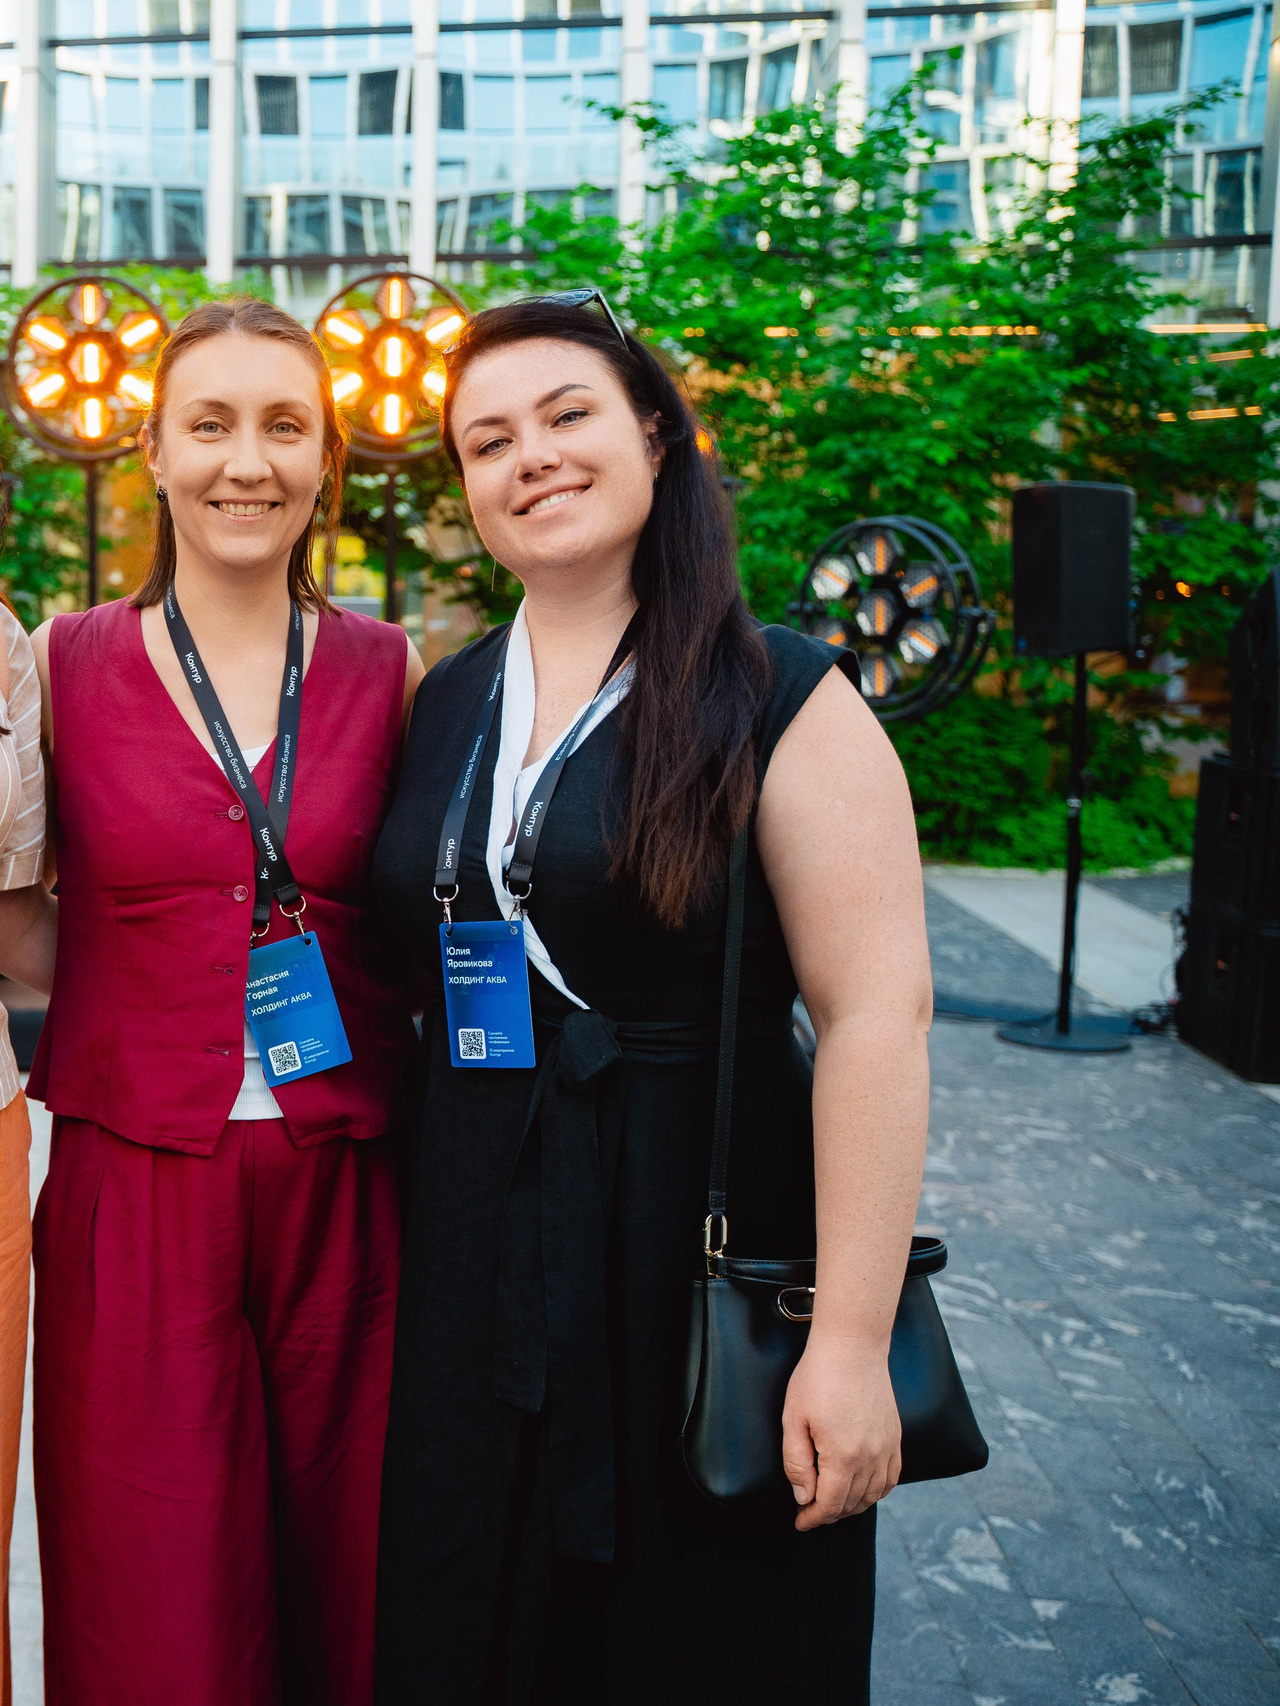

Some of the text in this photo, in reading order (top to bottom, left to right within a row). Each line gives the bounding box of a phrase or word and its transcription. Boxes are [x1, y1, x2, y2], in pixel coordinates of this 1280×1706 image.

[185, 651, 202, 684] Контур
[286, 665, 298, 697] Контур
[213, 720, 247, 789] искусство бизнеса
[277, 734, 291, 803] искусство бизнеса
[459, 734, 483, 799] искусство бизнеса
[524, 801, 544, 837] Контур
[259, 827, 278, 862] Контур
[443, 838, 456, 869] онтур
[446, 946, 471, 956] Юлия
[447, 958, 493, 970] Яровикова
[246, 986, 279, 1002] Горная
[448, 976, 508, 986] ХОЛДИНГ АКВА
[251, 991, 313, 1017] ХОЛДИНГ АКВА
